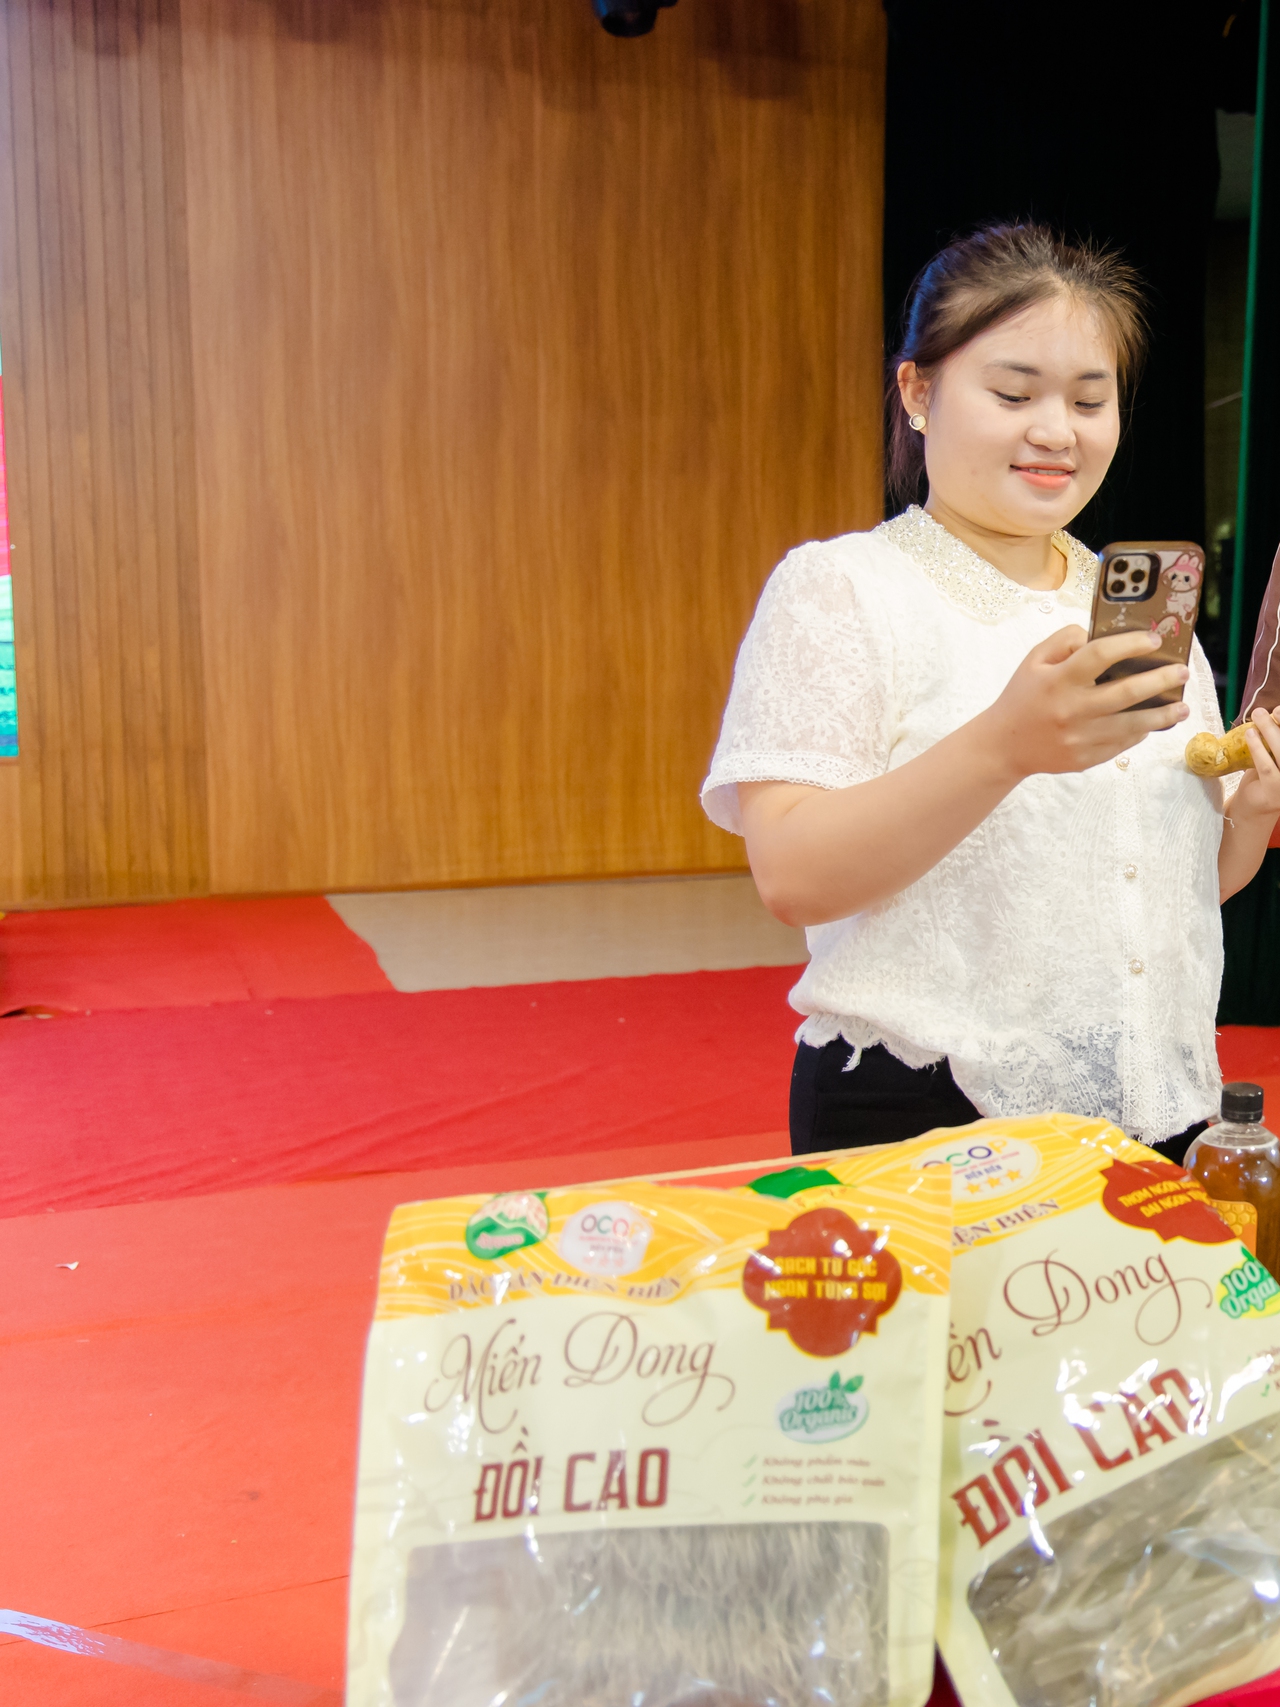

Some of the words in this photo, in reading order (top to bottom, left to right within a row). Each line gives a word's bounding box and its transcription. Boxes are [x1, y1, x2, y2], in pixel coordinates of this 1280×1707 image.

[580, 1213, 646, 1239] OCOP
[996, 1198, 1060, 1229] BIÊN
[1003, 1248, 1214, 1347] Dong
[423, 1317, 542, 1435] Miến
[563, 1310, 736, 1428] Dong
[779, 1406, 858, 1434] Organic
[473, 1425, 544, 1523] ĐỒI
[563, 1446, 671, 1513] CAO
[950, 1419, 1075, 1550] ĐỒI
[1072, 1368, 1210, 1473] CAO
